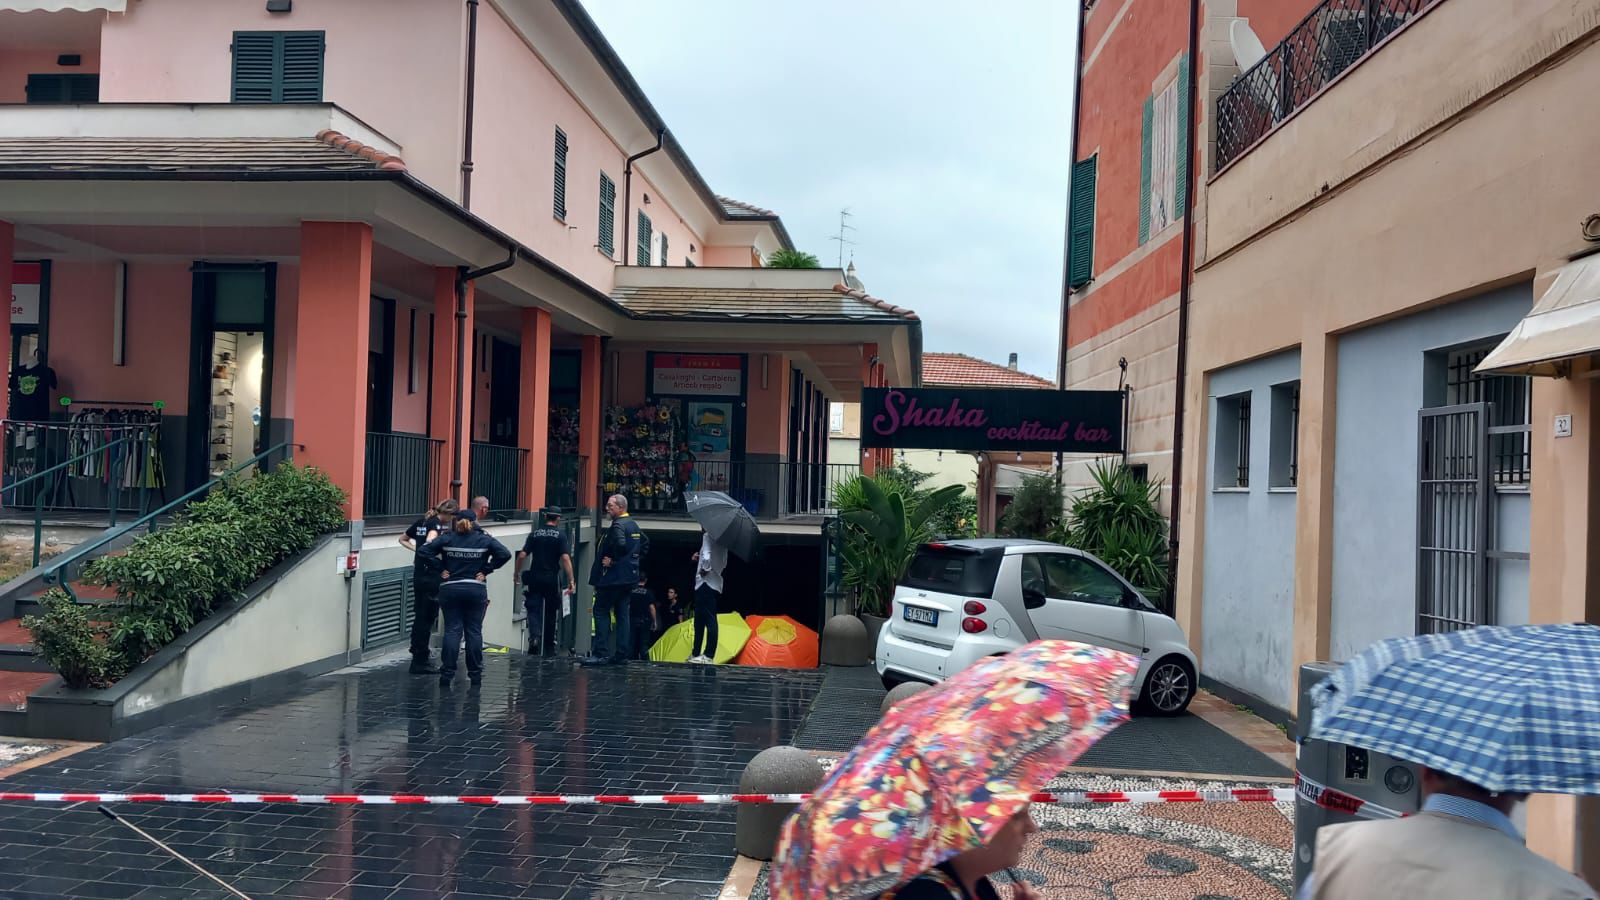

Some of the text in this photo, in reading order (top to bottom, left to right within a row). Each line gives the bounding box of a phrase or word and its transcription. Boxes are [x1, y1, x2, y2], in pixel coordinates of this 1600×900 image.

[873, 390, 988, 436] Shaka
[987, 420, 1112, 443] cocktail bar
